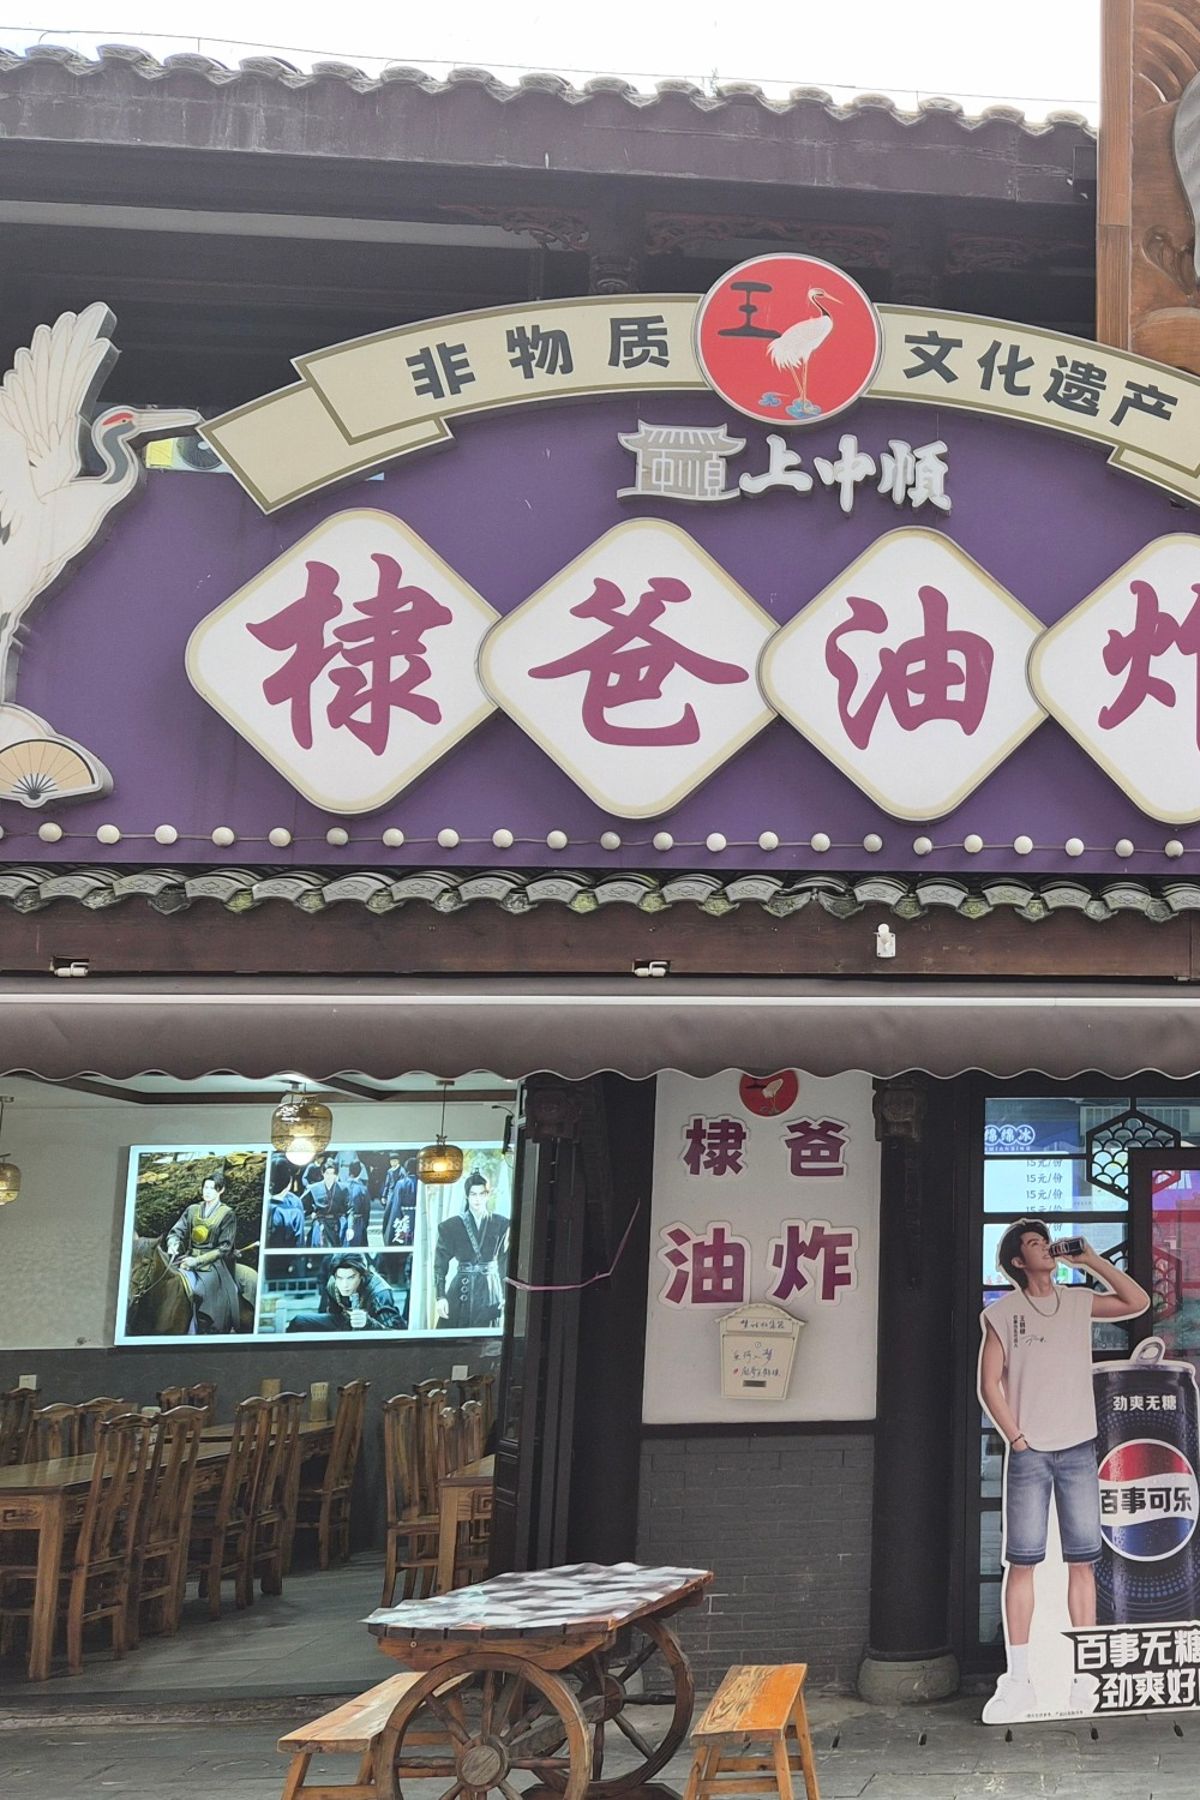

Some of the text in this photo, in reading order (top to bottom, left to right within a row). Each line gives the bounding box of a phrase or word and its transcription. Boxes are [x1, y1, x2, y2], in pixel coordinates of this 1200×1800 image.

[406, 314, 1179, 430] 非物质 文化遗产
[683, 1119, 847, 1177] 棣爸
[664, 1226, 854, 1304] 油炸
[1112, 1395, 1177, 1412] 劲爽无糖
[1100, 1486, 1193, 1515] 百事可乐
